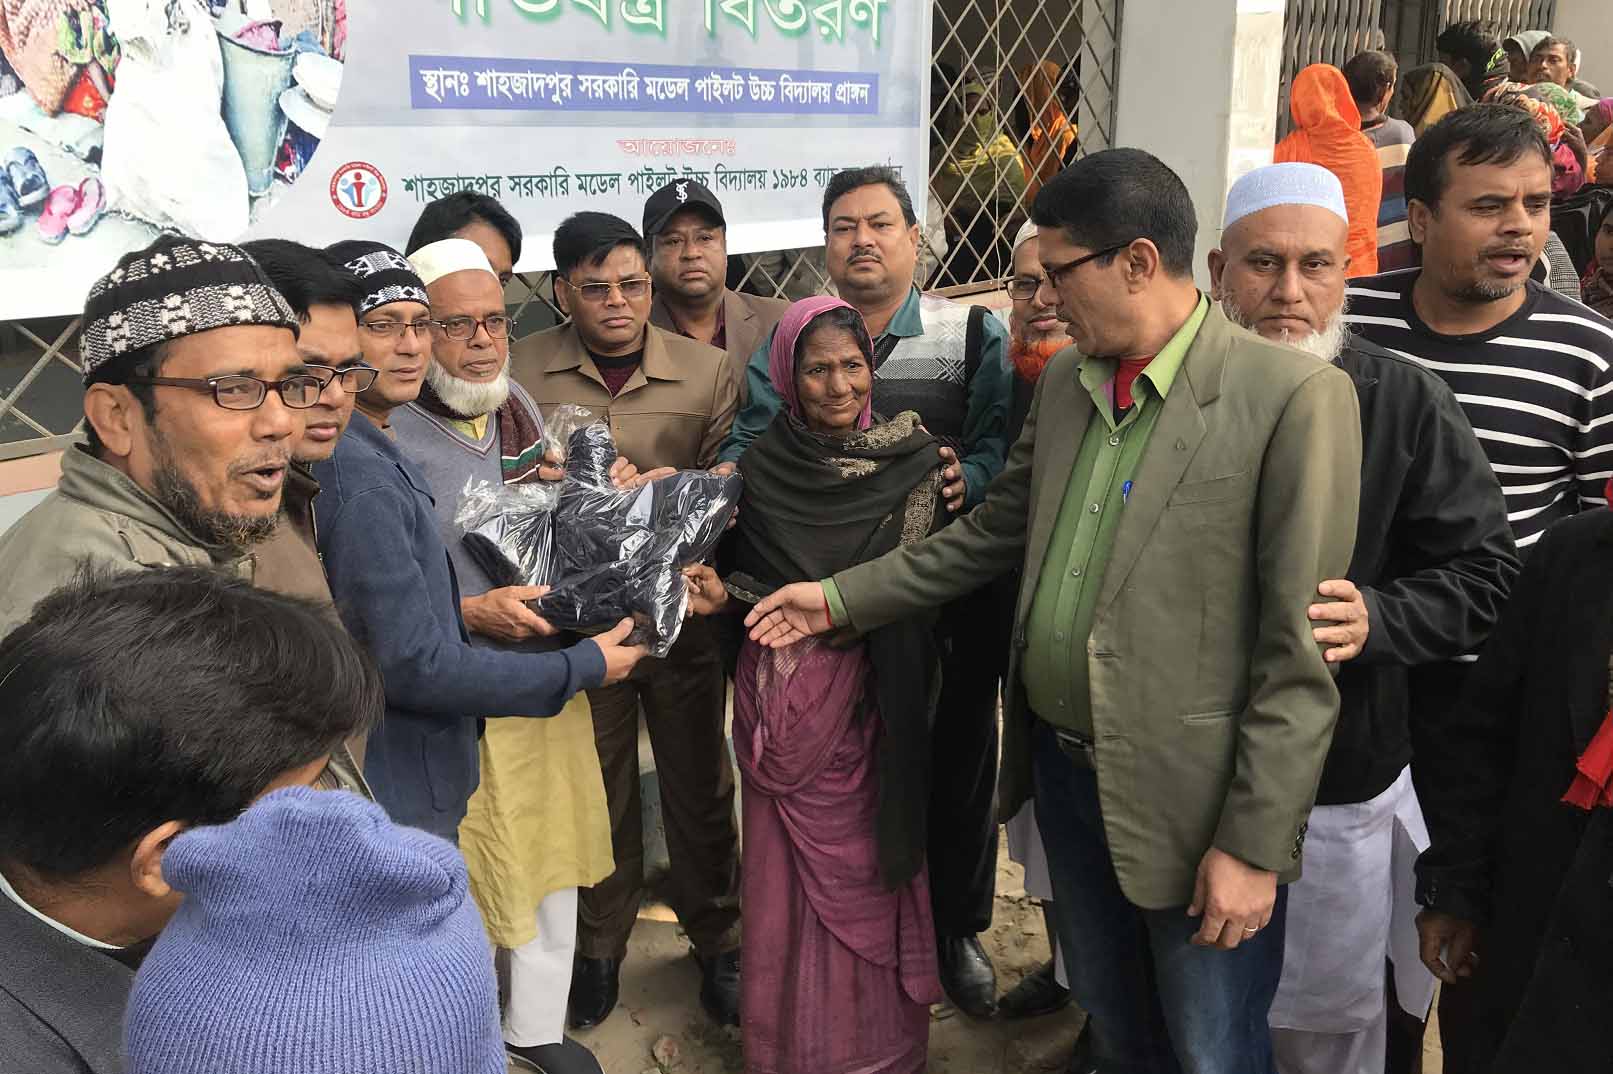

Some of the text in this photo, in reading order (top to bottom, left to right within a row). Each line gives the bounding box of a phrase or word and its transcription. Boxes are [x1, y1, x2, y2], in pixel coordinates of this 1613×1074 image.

[474, 68, 573, 105] শাহজাদপুর
[577, 68, 641, 100] সরকারি
[644, 76, 690, 101] মডেল
[694, 71, 744, 104] পাইলট
[749, 72, 777, 103] উচ্চ
[779, 74, 833, 104] বিদ্যালয়
[400, 172, 503, 201] শাহজাদপর
[507, 166, 571, 198] সরকারি
[575, 172, 623, 196] মডেল
[713, 163, 768, 192] বিদ্যালয়
[772, 168, 808, 190] ১৯৮৪
